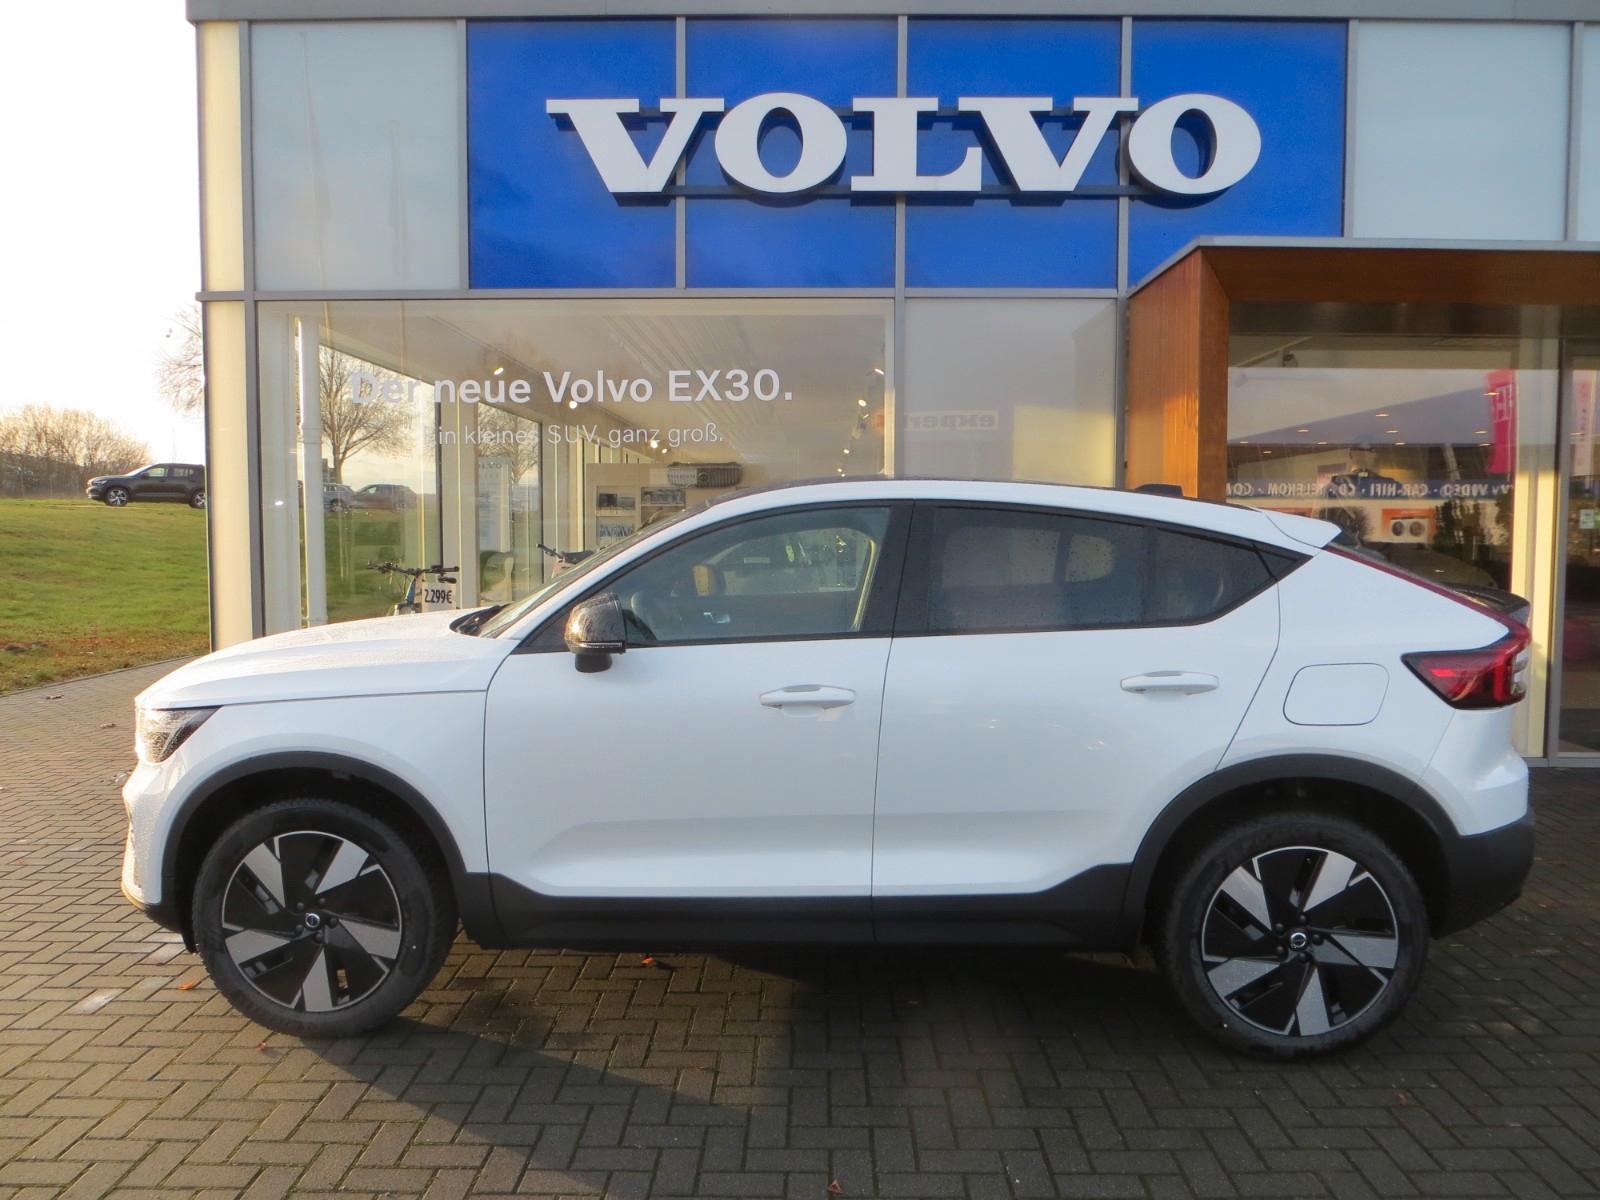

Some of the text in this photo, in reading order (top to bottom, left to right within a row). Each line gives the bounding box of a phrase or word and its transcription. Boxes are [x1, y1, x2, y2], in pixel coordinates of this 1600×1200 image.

[546, 92, 1262, 195] VOLVO
[351, 368, 793, 404] Der neue Volvo EX30.
[465, 424, 539, 444] kleines
[547, 423, 601, 446] SUV,
[608, 428, 661, 448] ganz
[668, 422, 724, 447] groß.
